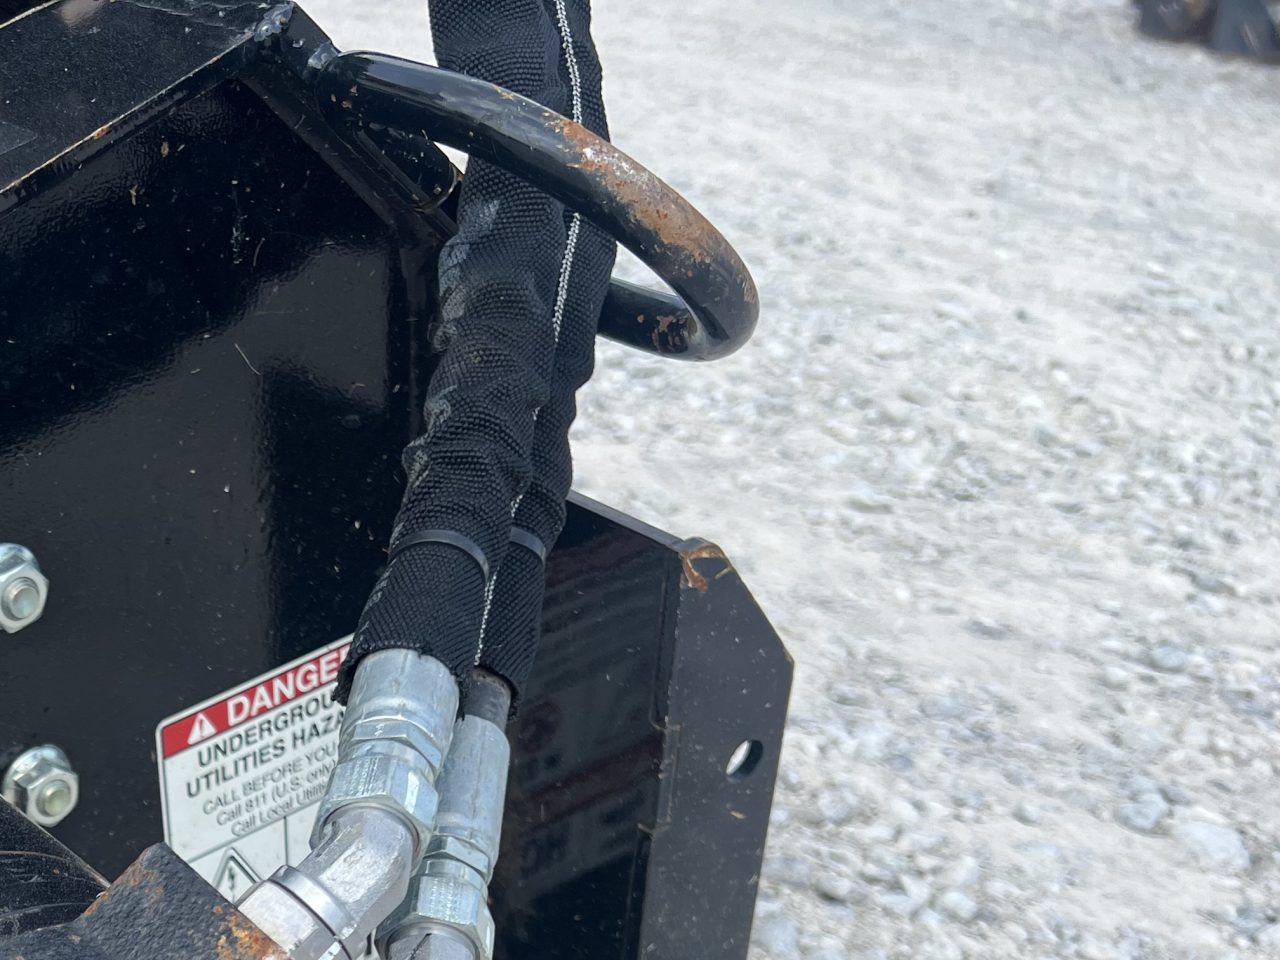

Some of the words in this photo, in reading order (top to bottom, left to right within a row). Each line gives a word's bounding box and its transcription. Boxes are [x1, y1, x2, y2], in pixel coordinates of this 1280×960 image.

[186, 738, 285, 798] UTILITIES
[292, 711, 345, 750] HAZA
[198, 689, 333, 767] UNDERGROU
[202, 789, 240, 815] CALL
[243, 757, 303, 796] BEFORE
[305, 741, 337, 765] YOU
[216, 803, 242, 826] Call
[231, 814, 257, 837] Call
